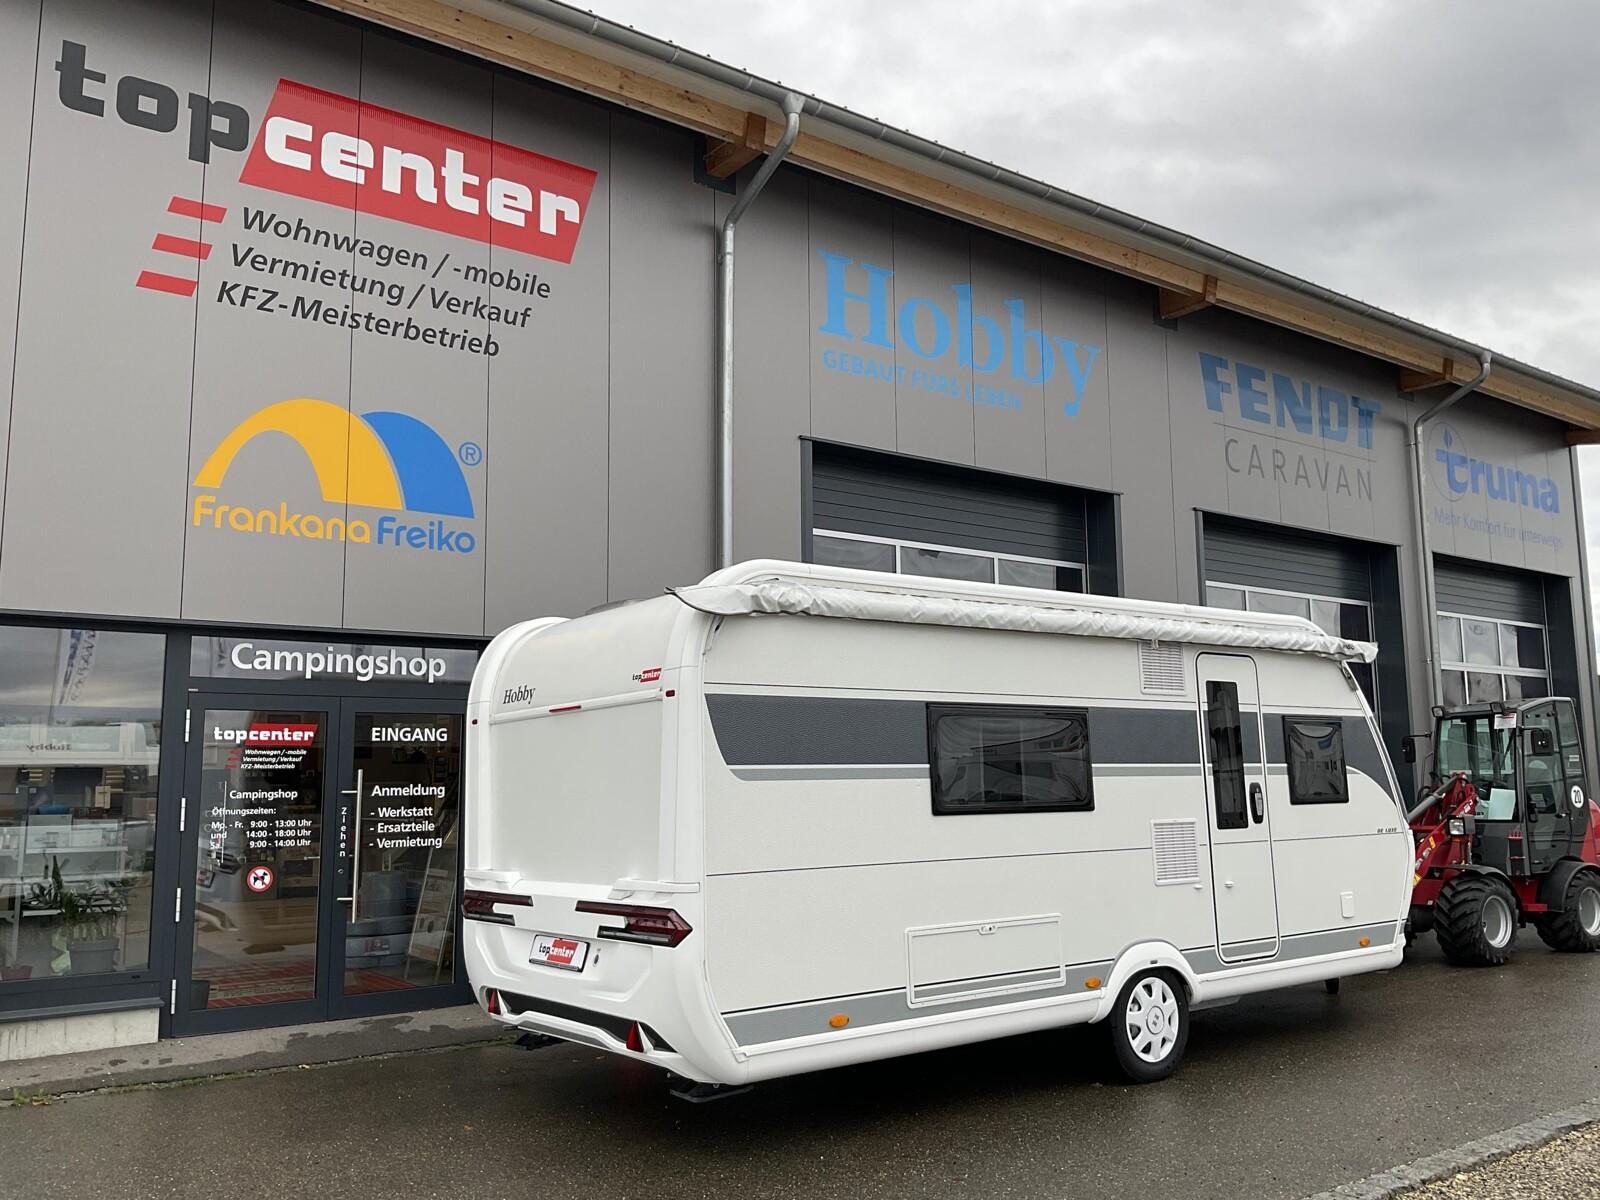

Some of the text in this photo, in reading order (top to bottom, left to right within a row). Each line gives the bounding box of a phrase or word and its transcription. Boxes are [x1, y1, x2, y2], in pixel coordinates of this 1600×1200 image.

[242, 206, 429, 270] Wohnwagen
[231, 243, 405, 306] Vermietung
[430, 287, 531, 328] Verkauf
[216, 281, 500, 357] KFZ-Meisterbetrieb
[816, 249, 1101, 417] Hobby
[823, 350, 905, 385] GEBAUT
[1199, 351, 1383, 450] FENDT
[1225, 438, 1373, 501] CARAVAN
[1436, 447, 1561, 514] truma
[193, 494, 476, 553] Frankana Freiko
[231, 643, 447, 683] Campingshop
[502, 684, 536, 704] Hobby
[214, 726, 314, 744] topcenter
[371, 727, 448, 742] EINGANG
[229, 789, 298, 801] Campingshop
[371, 784, 446, 799] Anmeldung
[1573, 789, 1582, 804] 20
[211, 806, 277, 817] Öffnungszeiten:
[378, 806, 434, 818] Werkstatt
[234, 821, 244, 829] Fr.
[250, 820, 268, 828] 9:00
[275, 820, 296, 828] 13:00
[298, 819, 312, 827] Uhr
[377, 821, 435, 833] Ersatzteile
[210, 831, 228, 839] und
[245, 830, 267, 838] 14:00
[274, 829, 296, 837] 18:00
[297, 828, 311, 837] Uhr
[249, 840, 267, 848] 9:00
[274, 839, 296, 847] 14:00
[296, 838, 311, 846] Uhr
[376, 837, 443, 849] Vermietung
